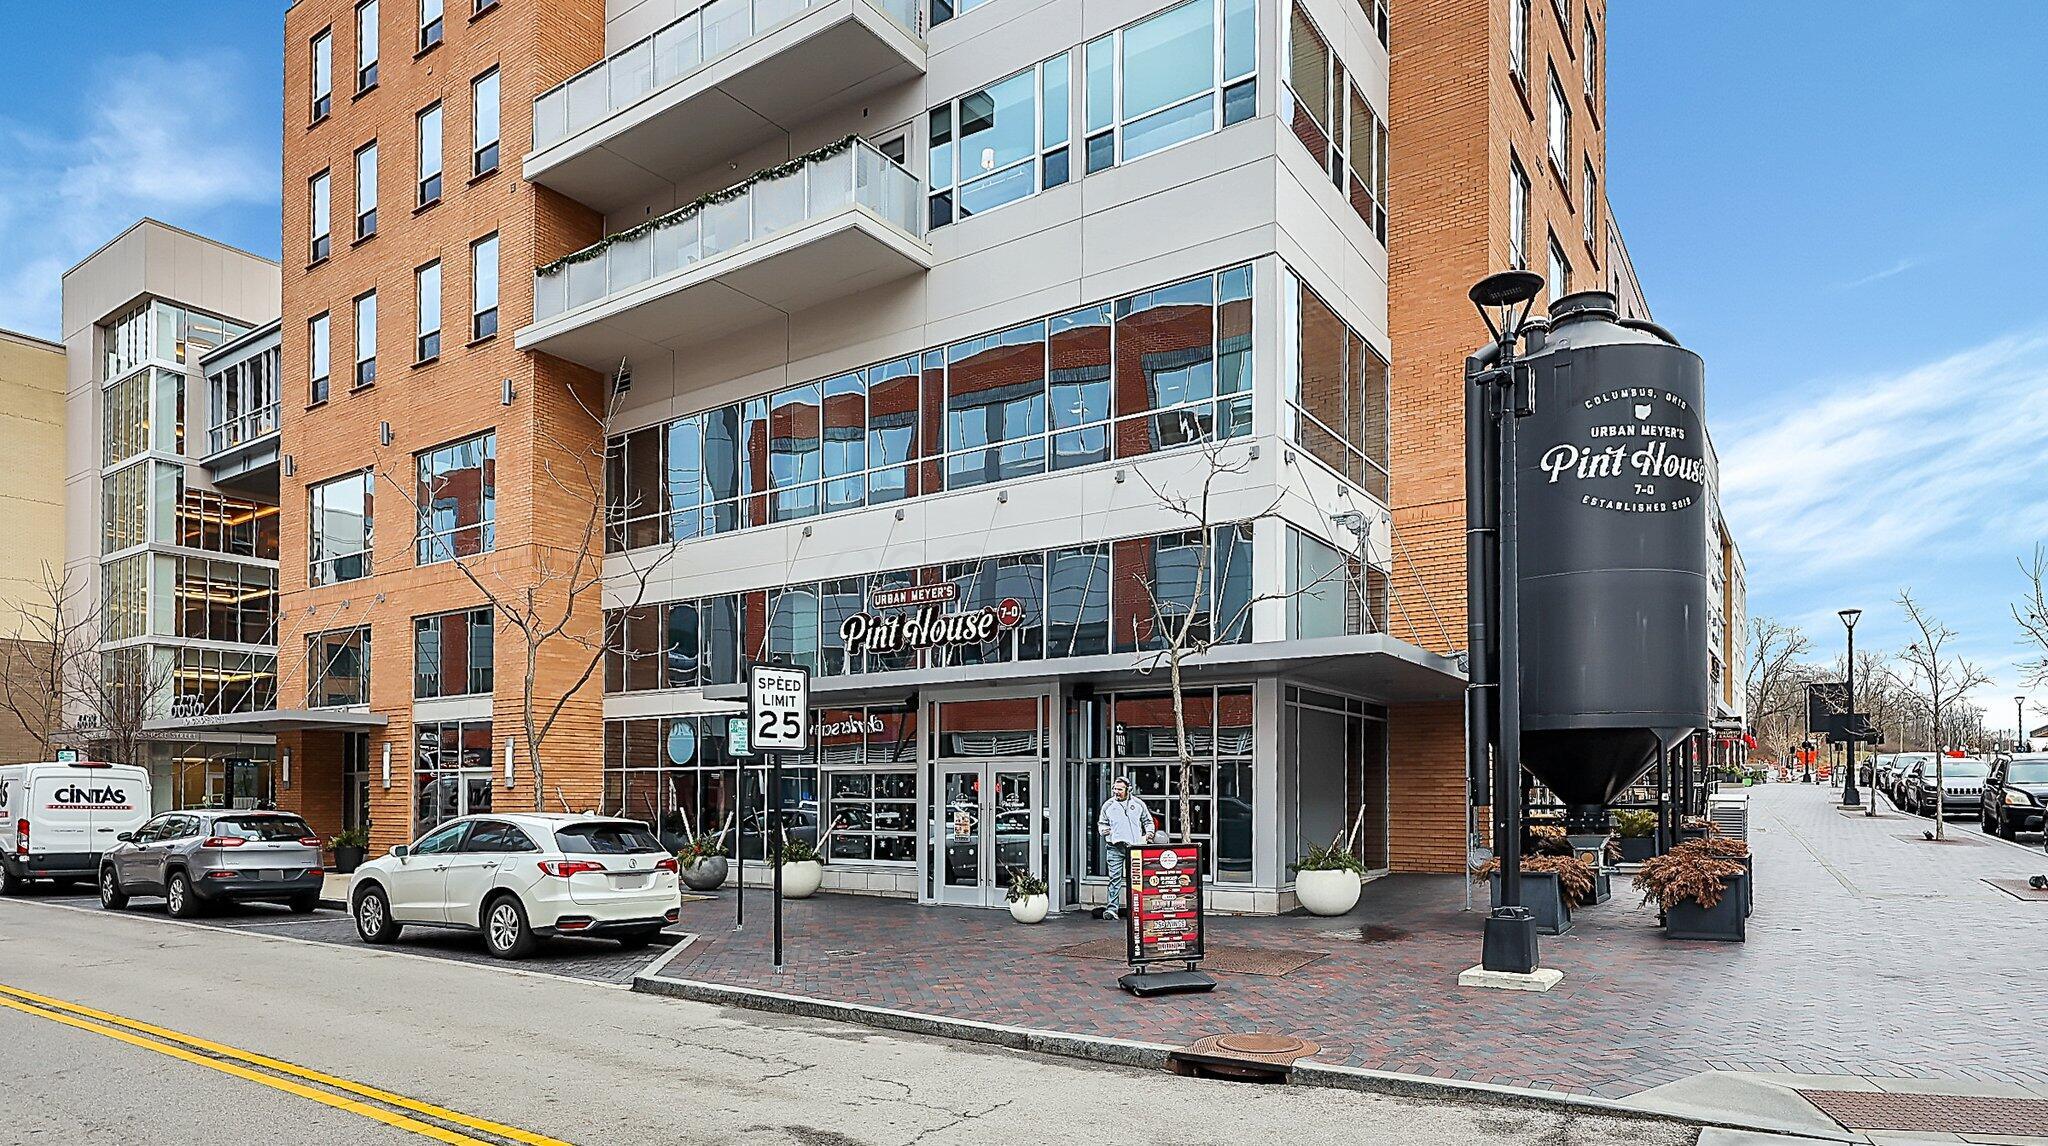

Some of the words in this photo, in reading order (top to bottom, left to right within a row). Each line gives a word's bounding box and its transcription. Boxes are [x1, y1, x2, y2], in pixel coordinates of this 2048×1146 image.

[1585, 388, 1657, 409] COLUMBUS,
[1666, 392, 1687, 410] OHIO
[1591, 425, 1635, 438] URBAN
[1641, 424, 1685, 439] MEYER'S
[1540, 443, 1627, 484] Pint
[1631, 440, 1704, 486] House
[1582, 495, 1666, 512] ESTABLISHED
[874, 592, 906, 606] URBAN
[911, 587, 954, 602] MEYER'S
[840, 612, 900, 653] Pint
[903, 604, 994, 646] House
[758, 677, 801, 692] SPEED
[762, 694, 796, 708] LIMIT
[758, 710, 801, 739] 25
[1132, 857, 1141, 886] LUNCH
